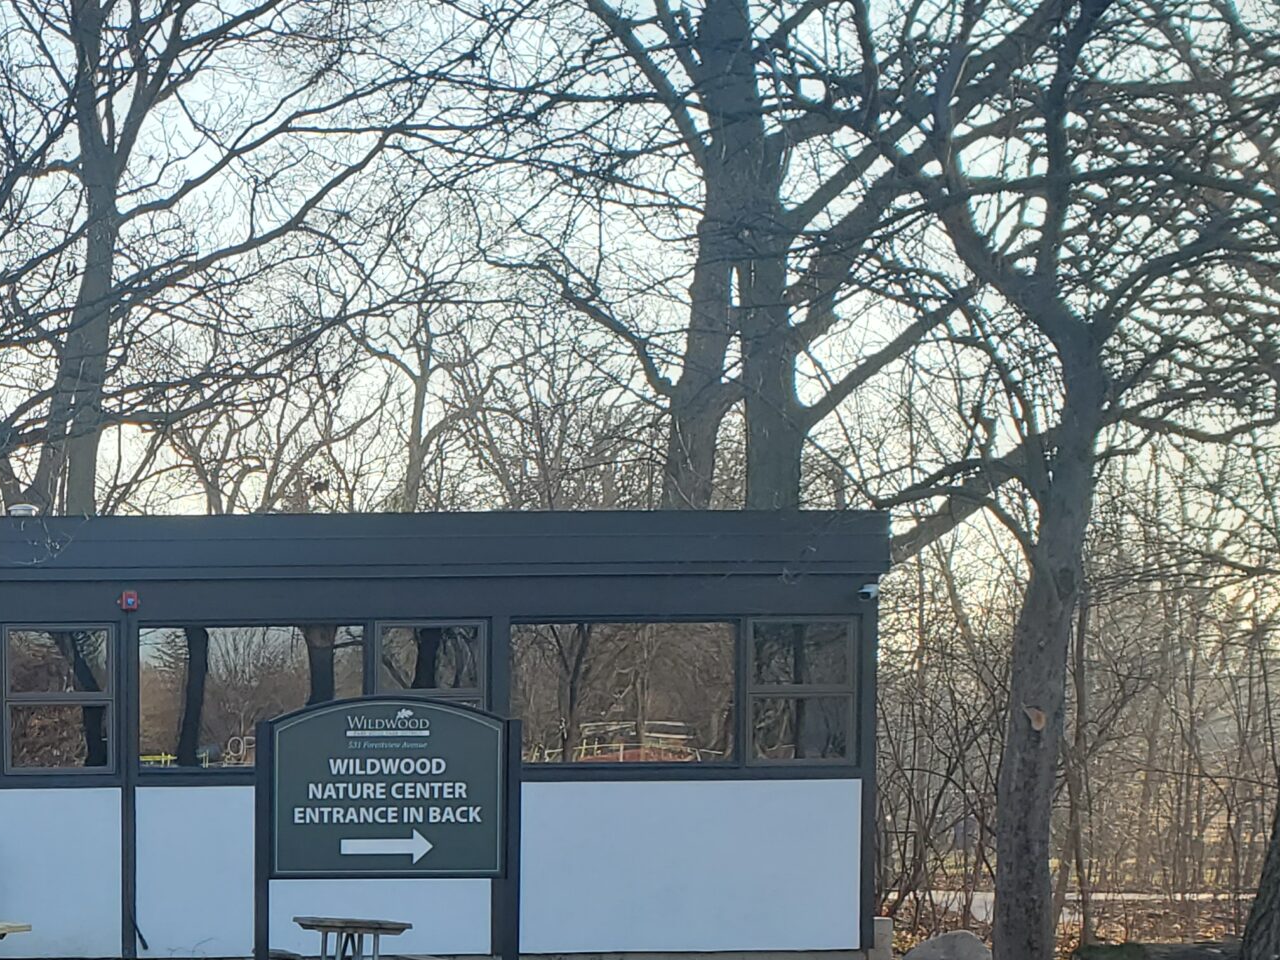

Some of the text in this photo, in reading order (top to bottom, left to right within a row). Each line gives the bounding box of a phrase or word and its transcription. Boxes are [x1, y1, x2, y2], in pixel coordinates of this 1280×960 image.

[347, 715, 430, 729] WILDWOOD
[329, 758, 446, 775] WILDWOOD
[308, 782, 467, 799] NATURE CENTER
[293, 806, 482, 823] ENTRANCE IN BACK
